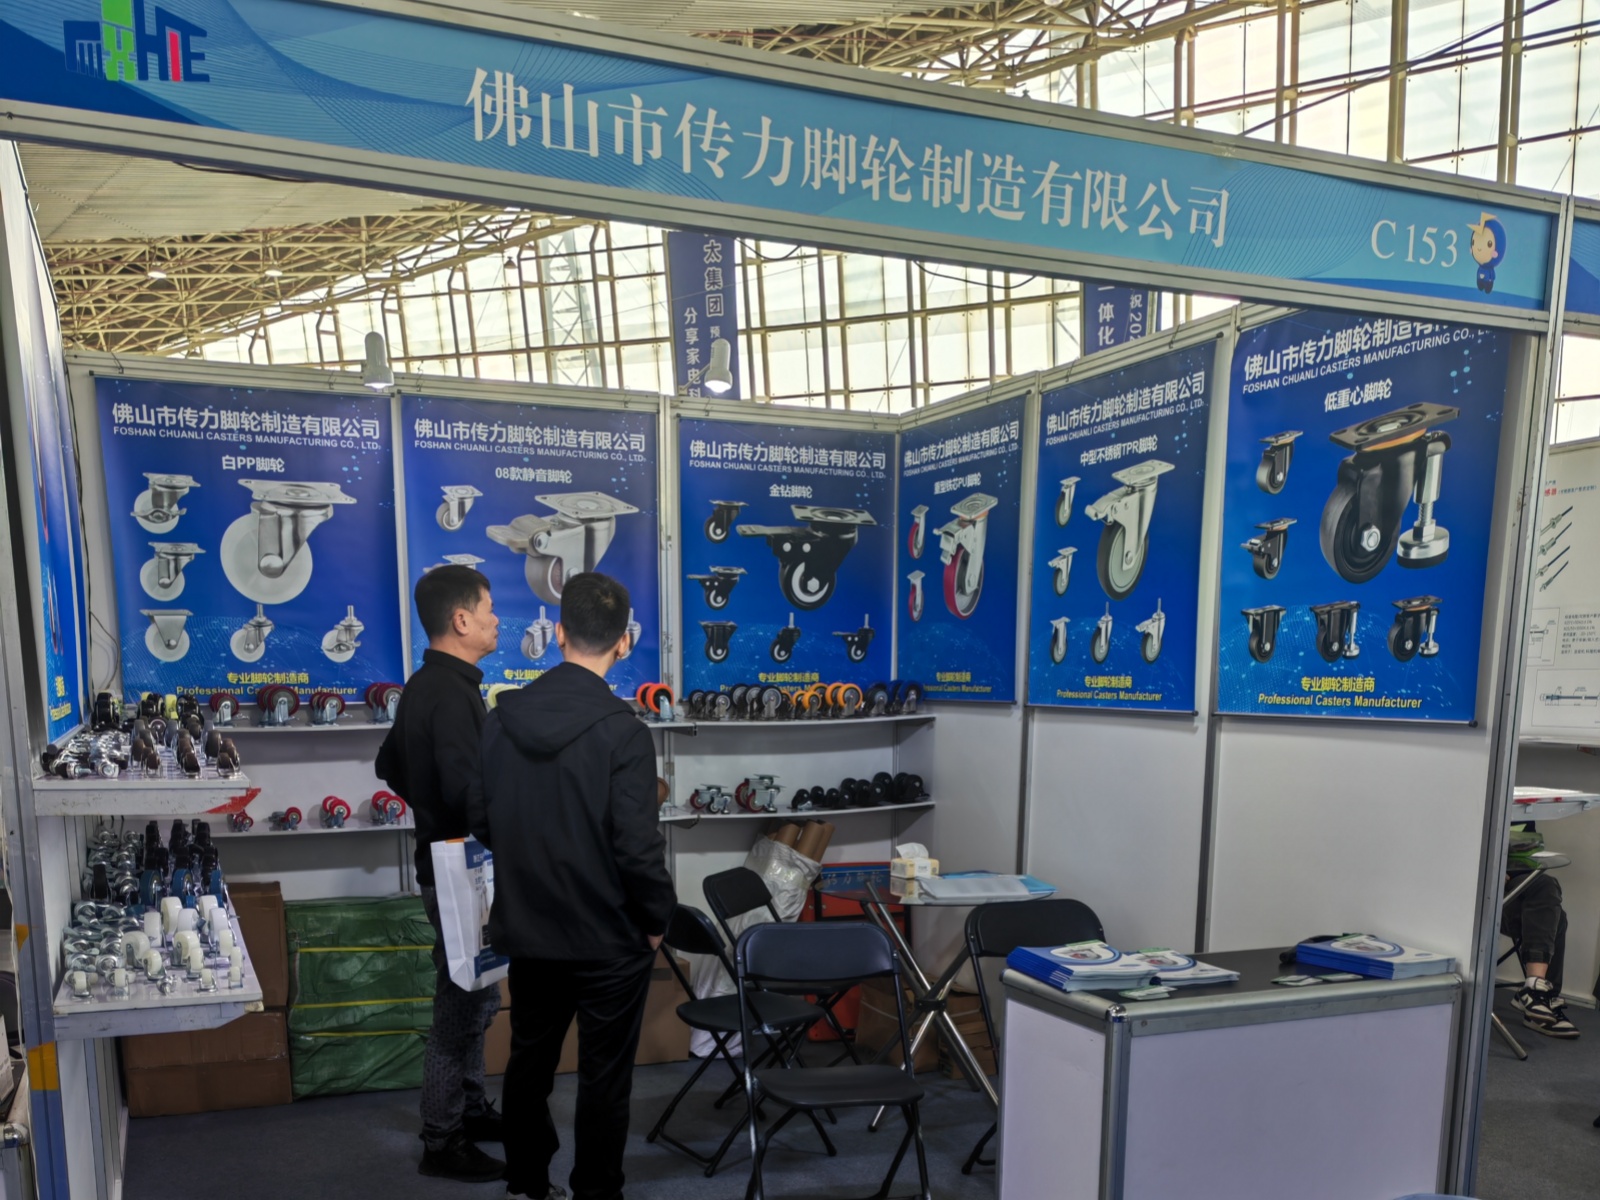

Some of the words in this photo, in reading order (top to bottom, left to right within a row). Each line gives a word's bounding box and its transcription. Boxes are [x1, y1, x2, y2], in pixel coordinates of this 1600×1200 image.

[465, 66, 1230, 249] 佛山市传力脚轮制造有限公司
[1097, 286, 1115, 346] 一体化
[1243, 378, 1280, 394] FOSHAN
[1282, 367, 1319, 386] CHUANLI
[1319, 356, 1361, 377] CASTERS
[1363, 332, 1451, 365] MANUFACTURING
[1046, 371, 1206, 436] 佛山市传力脚轮制造有限公司
[1324, 378, 1393, 412] 低重心脚轮
[112, 402, 380, 439] 佛山市传力脚轮制造有限公司
[1045, 435, 1068, 446] FOSHAN
[1068, 429, 1092, 441] CHUANLI
[1093, 420, 1120, 434] CASTERS
[1120, 405, 1175, 427] MANUFACTURING
[113, 426, 156, 437] FOSHAN
[159, 429, 204, 440] CHUANLI
[206, 431, 253, 443] CASTERS
[255, 435, 338, 448] MANUFACTURING
[414, 418, 646, 452] 佛山市传力脚轮制造有限公司
[904, 421, 1019, 468] 佛山市传力脚轮制造有限公司
[414, 440, 452, 450] FOSHAN
[454, 443, 493, 453] CHUANLI
[494, 445, 535, 455] CASTERS
[537, 447, 609, 460] MANUFACTURING
[690, 440, 886, 470] 佛山市传力脚轮制造有限公司
[222, 455, 285, 472] 白PP脚轮
[495, 466, 572, 483] 08款静音脚轮
[689, 460, 721, 469] FOSHAN
[723, 461, 756, 471] CHUANLI
[757, 464, 792, 473] CASTERS
[793, 466, 855, 477] MANUFACTURING
[769, 484, 813, 499] 金钻脚轮
[176, 686, 244, 696] Professional
[290, 687, 357, 696] Manufacturer
[227, 672, 309, 685] 专业脚轮制造商
[1301, 676, 1375, 692] 专业脚轮制造商
[1258, 693, 1313, 705] Professional
[1315, 695, 1351, 707] Casters
[1354, 695, 1422, 709] Manufacturer
